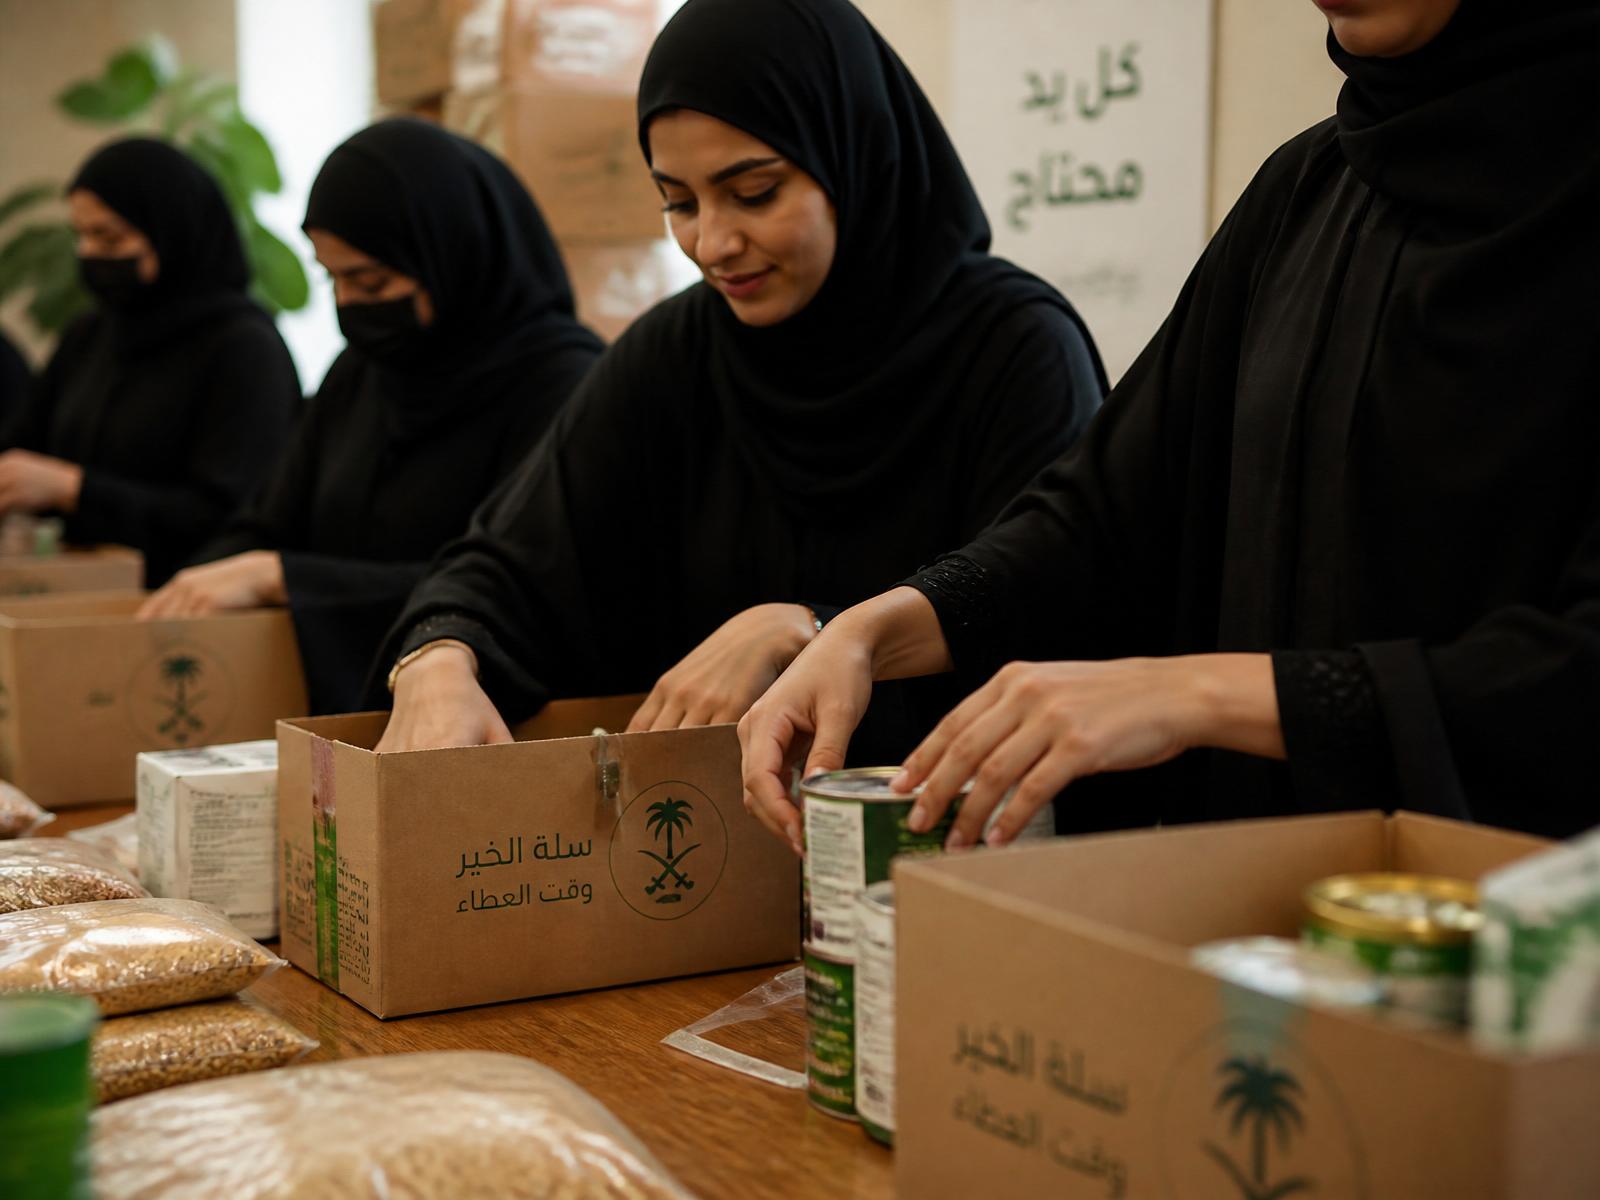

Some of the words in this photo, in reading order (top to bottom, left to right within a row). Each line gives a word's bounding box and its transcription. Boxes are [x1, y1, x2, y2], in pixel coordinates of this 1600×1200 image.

[1022, 71, 1066, 123] يد
[1075, 42, 1142, 119] كل
[455, 836, 522, 879] الخير
[533, 832, 593, 861] سلة
[455, 883, 531, 912] العطاء
[538, 879, 593, 904] وقت
